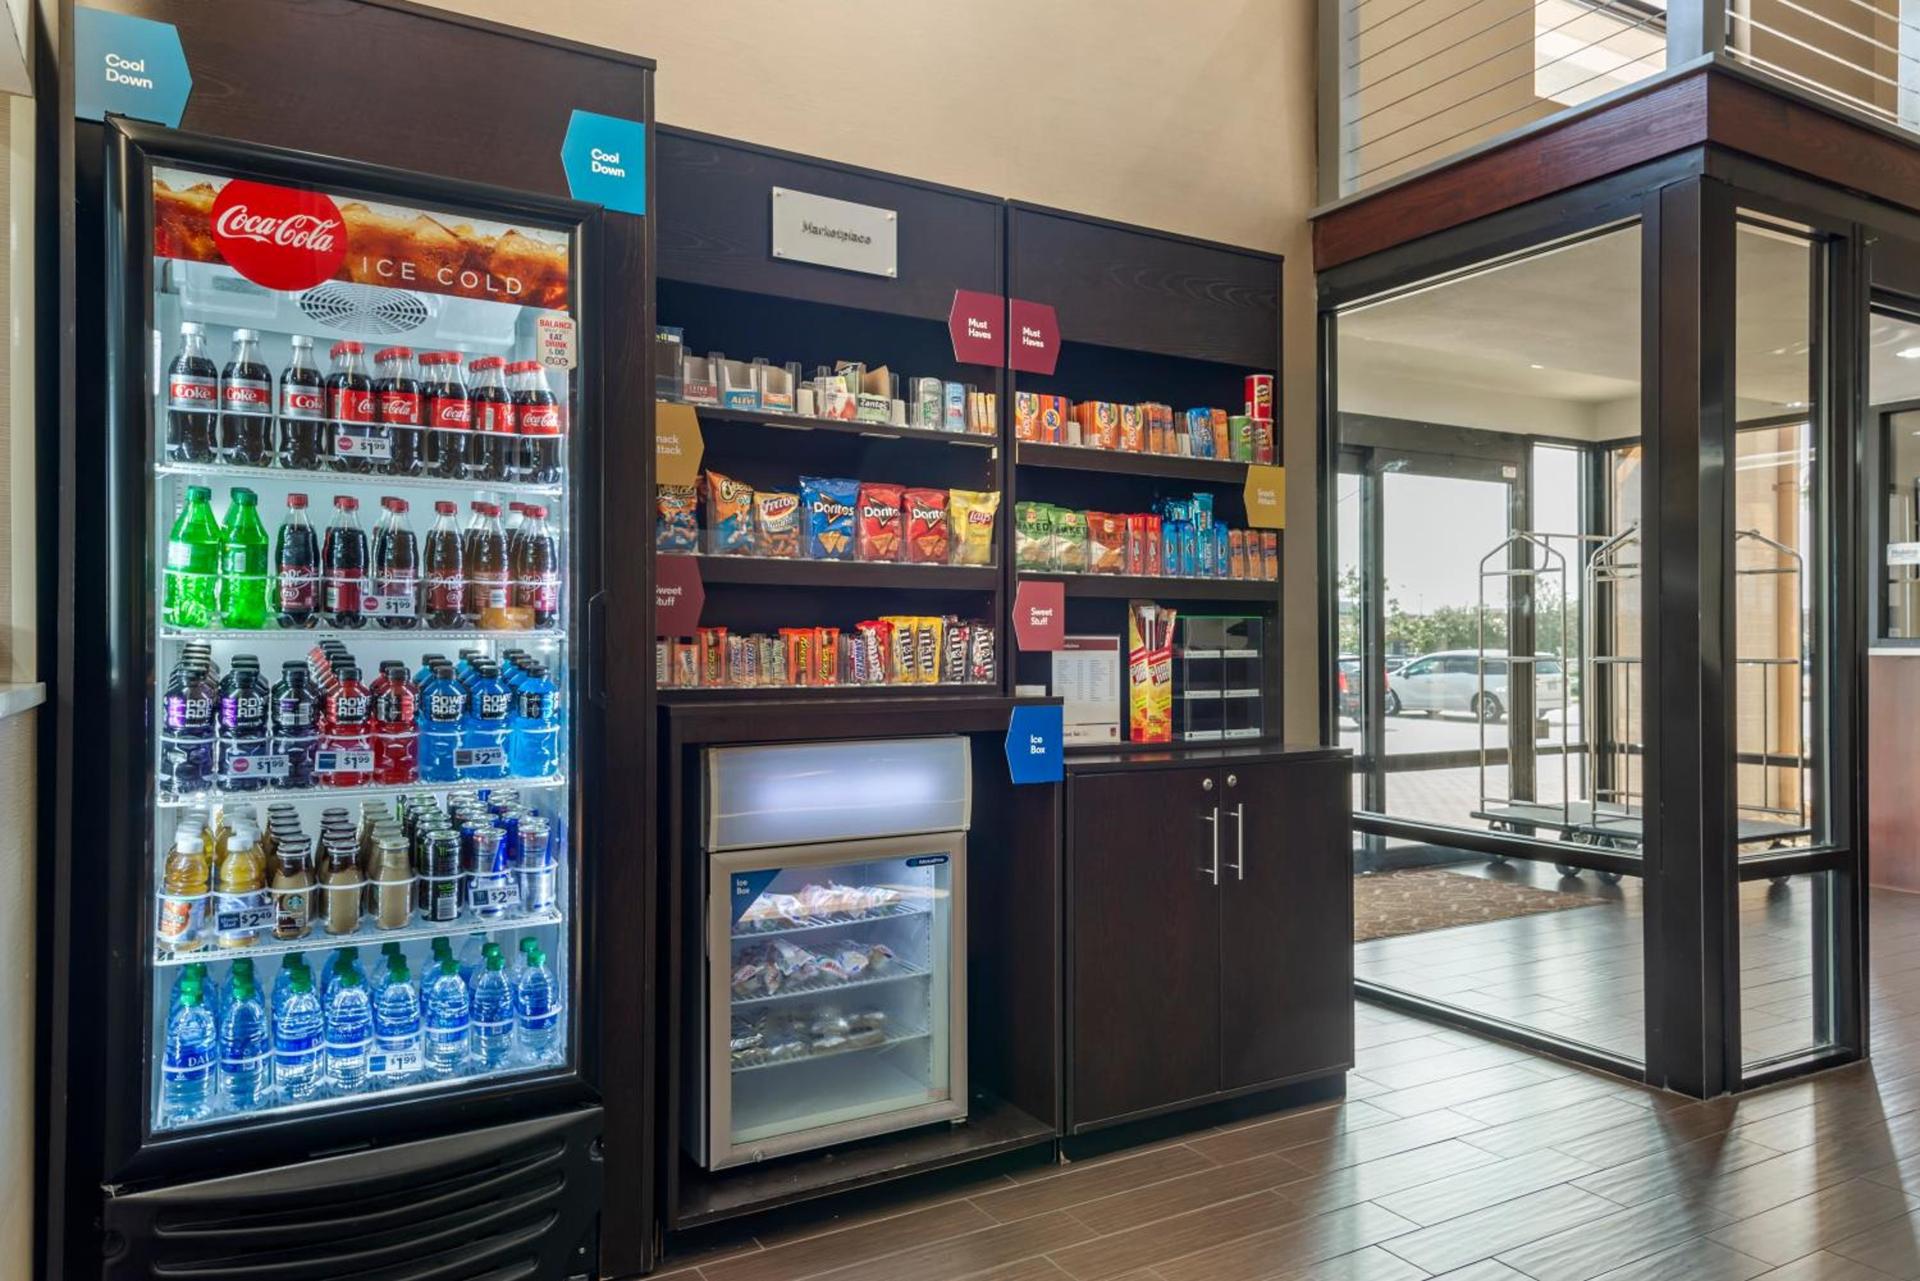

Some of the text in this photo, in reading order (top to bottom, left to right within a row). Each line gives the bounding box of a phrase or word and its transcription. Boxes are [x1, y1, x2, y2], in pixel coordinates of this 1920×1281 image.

[105, 53, 145, 73] Cool
[105, 68, 153, 90] Down
[591, 149, 619, 164] Cool
[591, 161, 625, 178] Down
[217, 204, 340, 252] Coca-Cola
[802, 220, 872, 245] Marketplace
[363, 256, 523, 295] ICE COLD
[968, 318, 988, 330] Must
[968, 328, 992, 340] Haves
[1022, 327, 1041, 338] Must
[1022, 337, 1044, 348] Haves
[175, 383, 211, 400] Coke
[226, 387, 257, 401] Coke
[656, 435, 679, 445] nack
[656, 445, 682, 455] ttack
[814, 502, 855, 516] Doritos
[1030, 607, 1053, 617] Sweet
[1030, 617, 1048, 626] Stuff
[1030, 734, 1043, 744] Ice
[1030, 745, 1045, 755] Box
